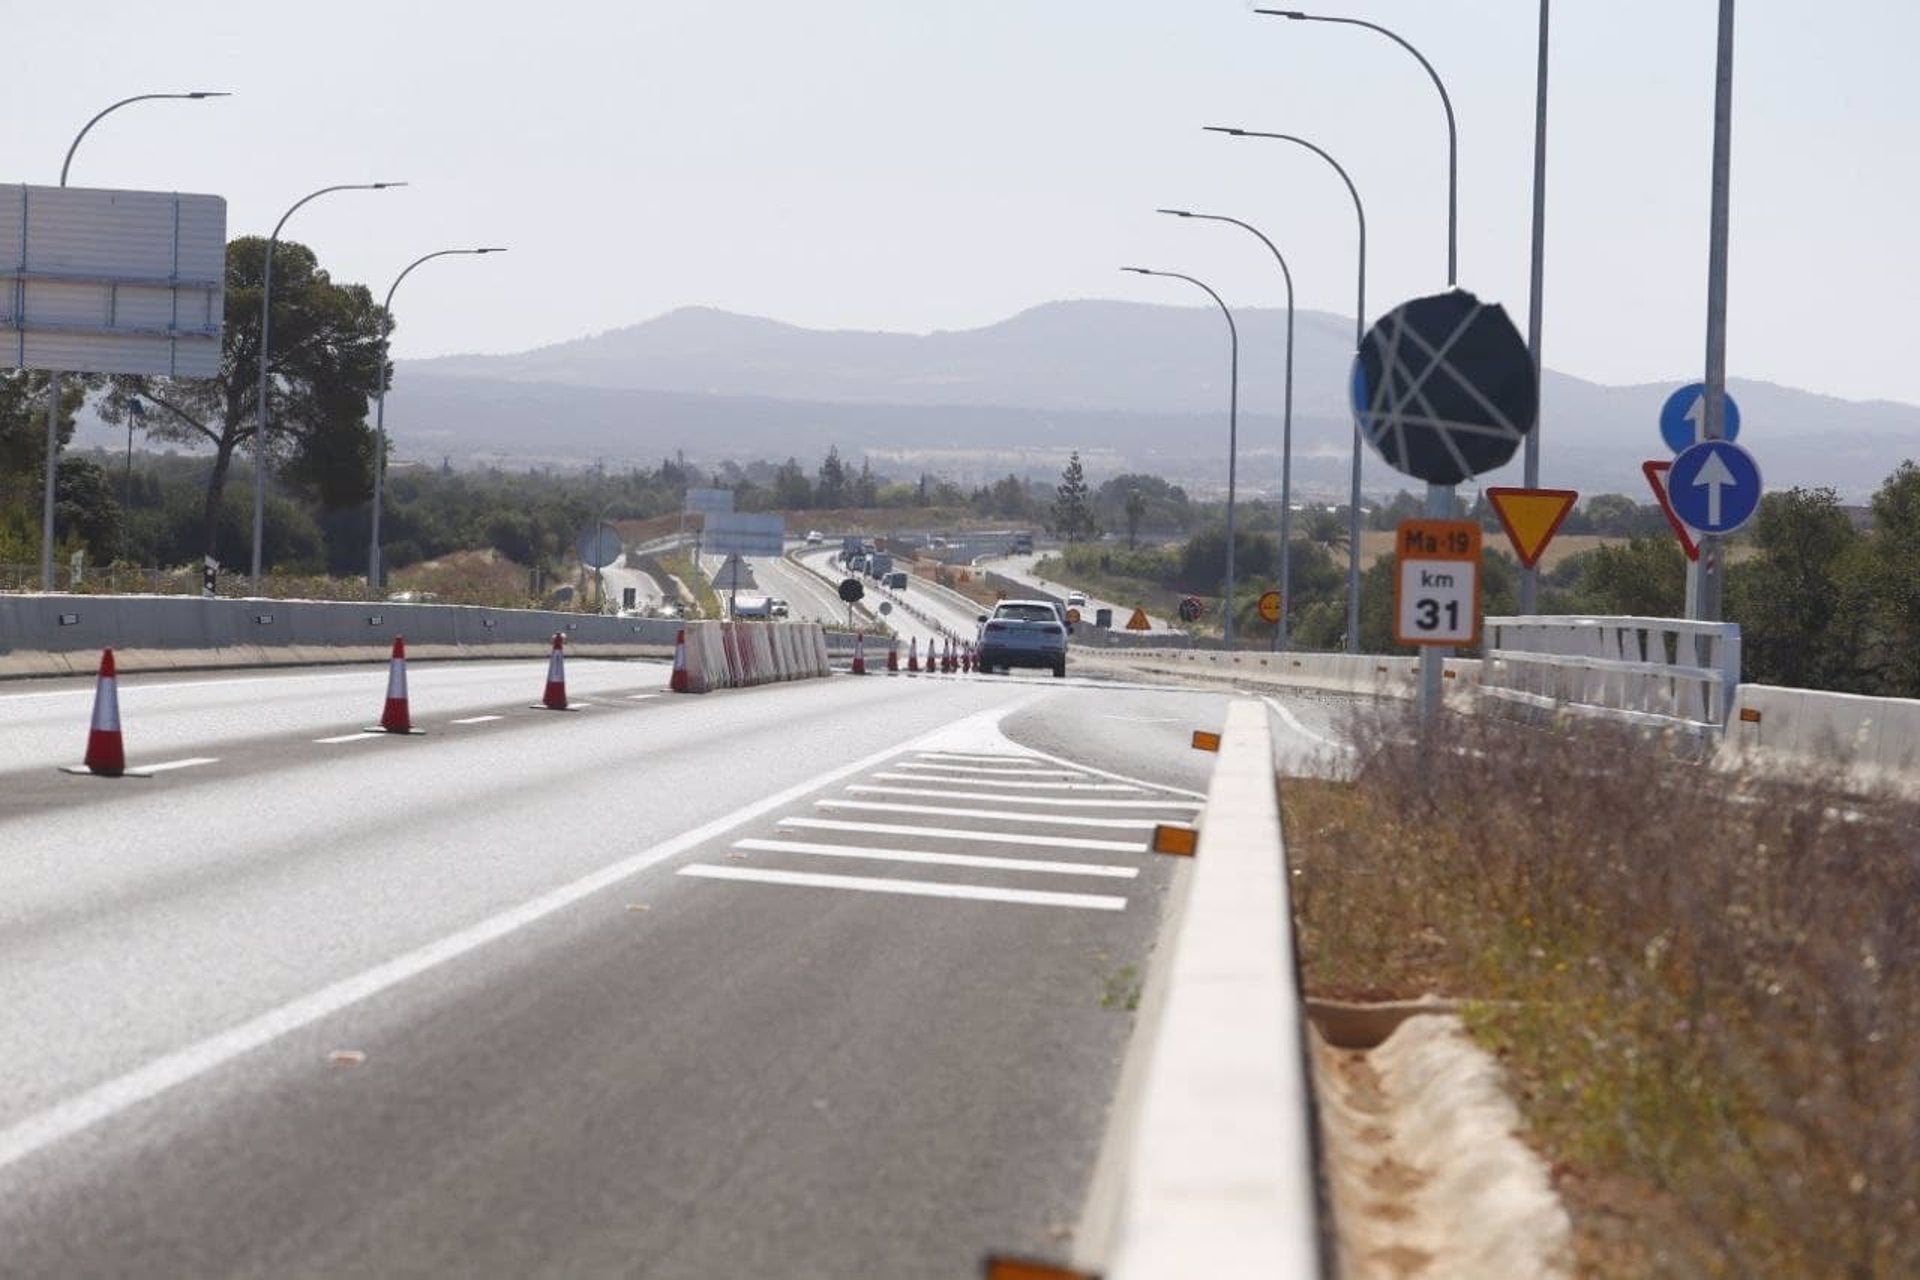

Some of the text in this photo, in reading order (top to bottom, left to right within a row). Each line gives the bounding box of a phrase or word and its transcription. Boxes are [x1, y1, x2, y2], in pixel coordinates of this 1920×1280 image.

[1406, 530, 1469, 553] Ma-19
[1421, 570, 1454, 588] km
[1415, 598, 1458, 631] 31
